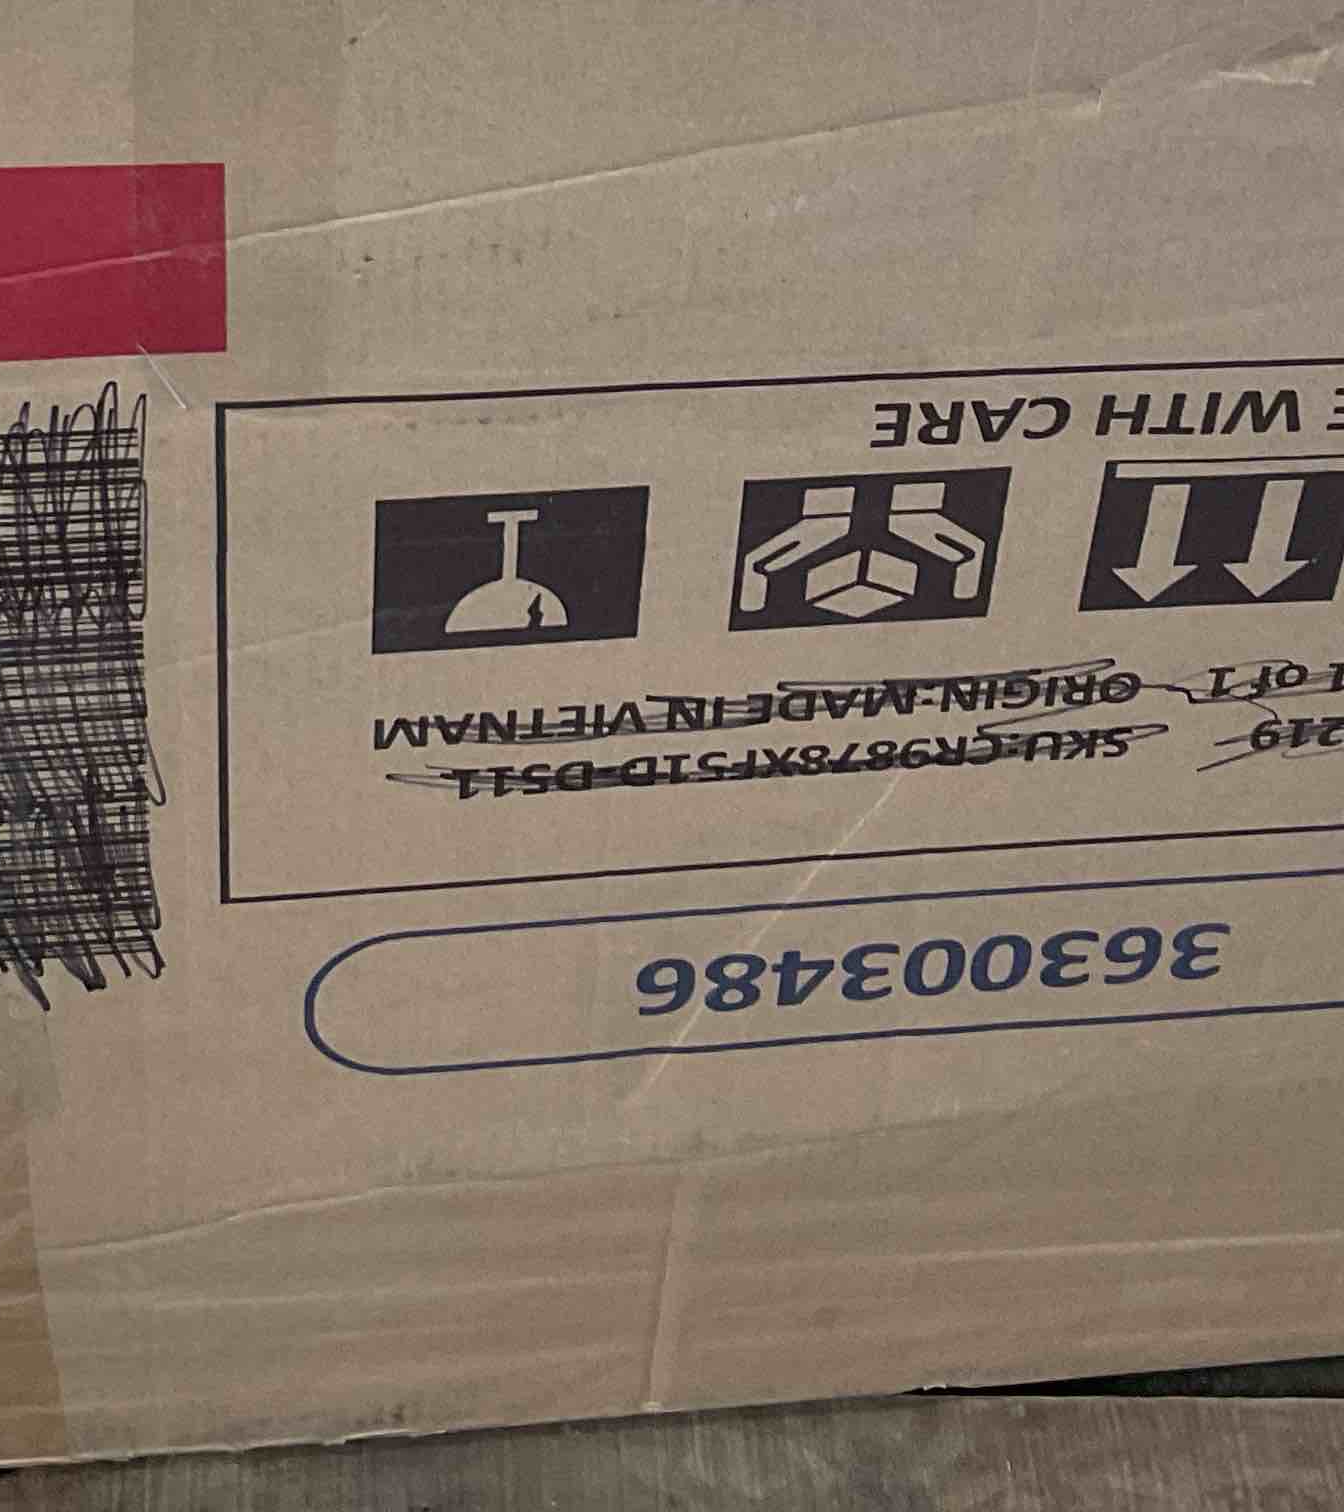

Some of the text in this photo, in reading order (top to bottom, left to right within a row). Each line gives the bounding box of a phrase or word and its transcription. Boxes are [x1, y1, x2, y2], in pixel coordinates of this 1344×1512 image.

[869, 396, 1073, 449] CARE
[1095, 389, 1301, 437] WITH
[373, 701, 646, 751] VIETNAM
[665, 697, 725, 731] IN
[634, 922, 1232, 1016] 363003486
